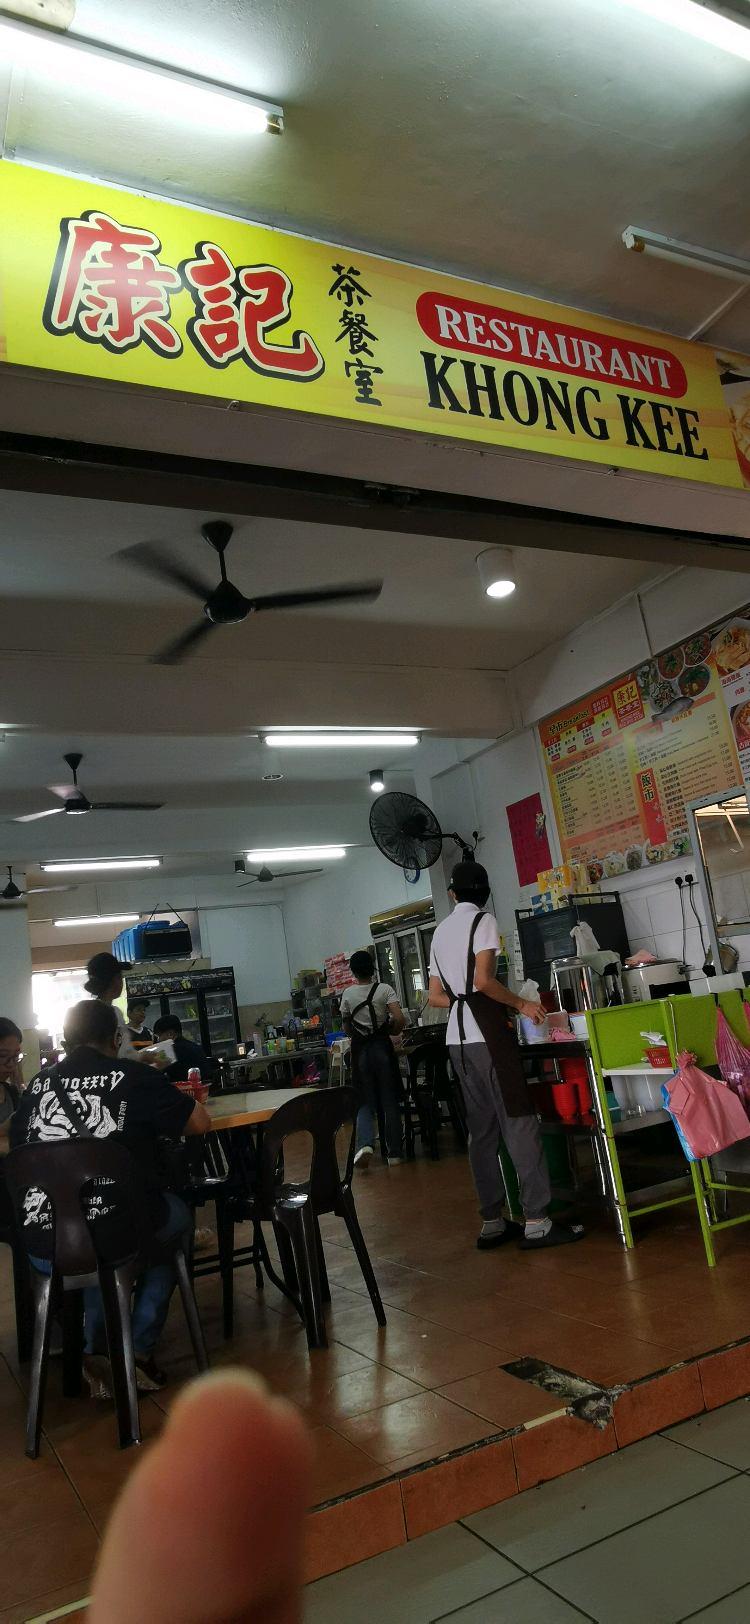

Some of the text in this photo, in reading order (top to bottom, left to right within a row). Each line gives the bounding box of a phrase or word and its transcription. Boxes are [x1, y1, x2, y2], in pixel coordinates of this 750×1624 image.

[46, 210, 324, 382] 康記
[328, 263, 383, 407] 茶餐室
[435, 304, 672, 390] RESTAURANT
[419, 350, 710, 461] KHONG KEE
[641, 773, 655, 802] 飯市
